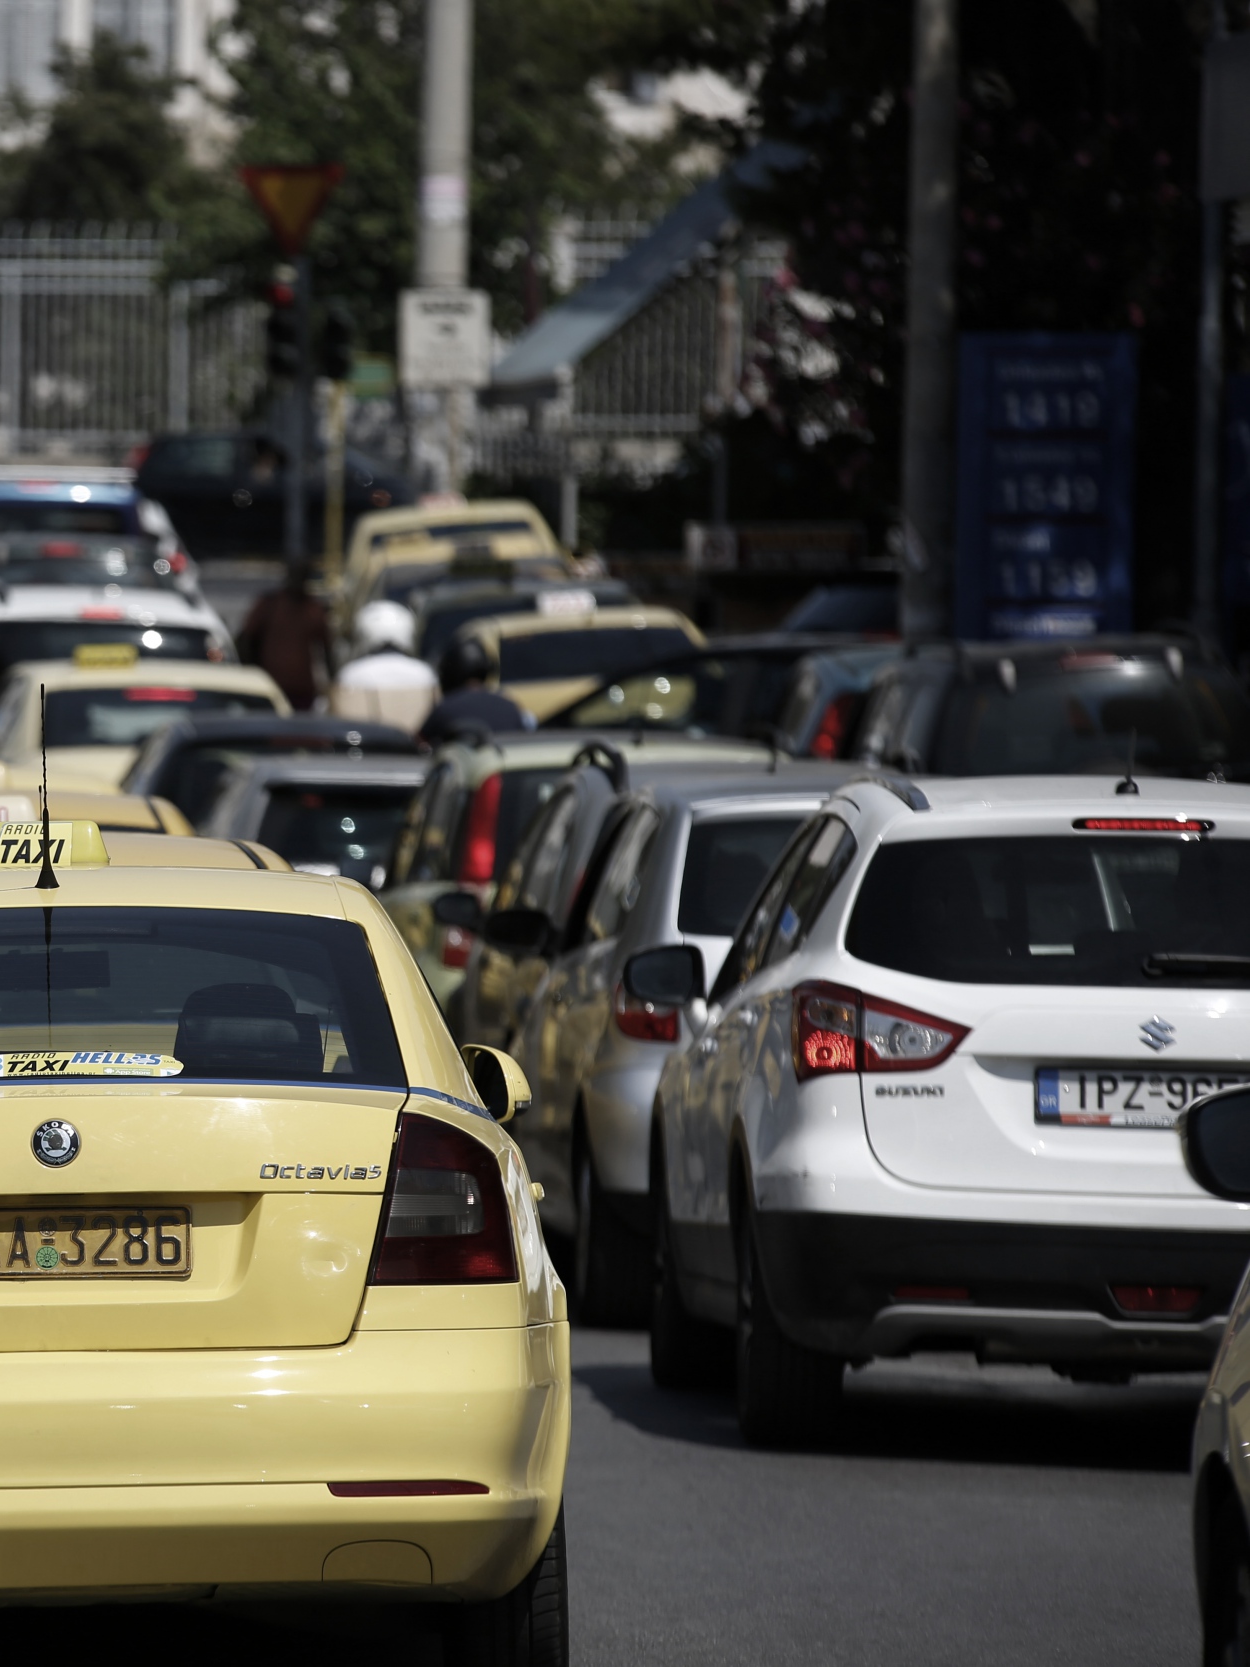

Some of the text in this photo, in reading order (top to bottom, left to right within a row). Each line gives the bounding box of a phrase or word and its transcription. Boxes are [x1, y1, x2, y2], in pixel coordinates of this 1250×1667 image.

[0, 839, 66, 864] TAXI
[10, 1052, 56, 1060] RADIO
[6, 1060, 70, 1073] TAXI
[874, 1084, 945, 1097] SUZUKI
